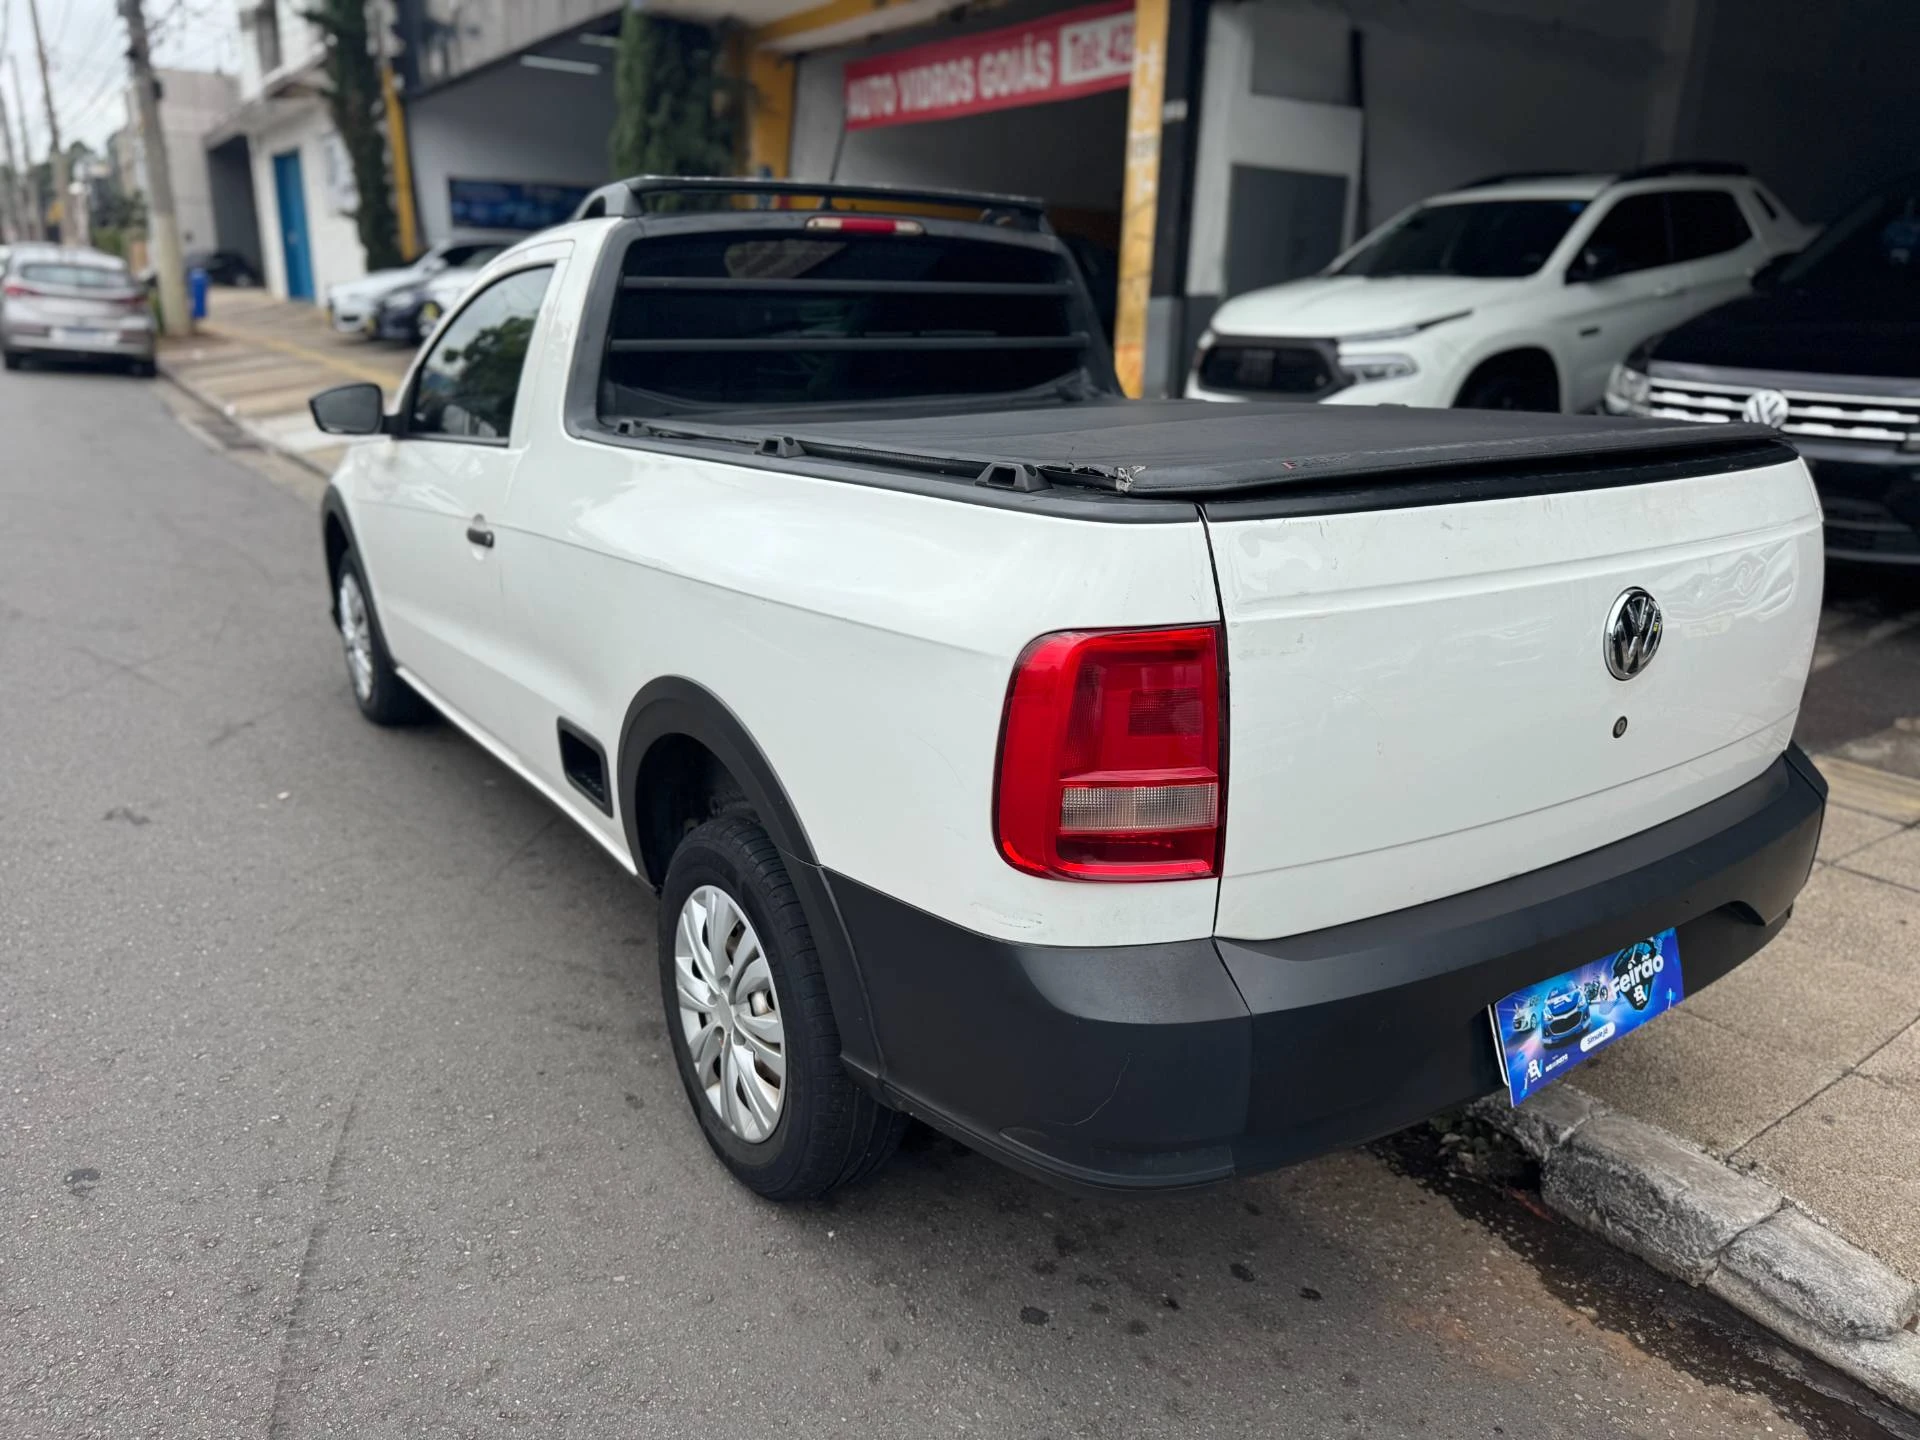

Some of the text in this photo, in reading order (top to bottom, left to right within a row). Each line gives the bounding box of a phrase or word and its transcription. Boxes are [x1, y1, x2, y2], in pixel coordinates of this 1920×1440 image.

[848, 74, 895, 119] AUTO
[898, 58, 974, 110] VIDROS
[980, 33, 1052, 98] GOIÁS
[1608, 954, 1664, 1002] Feirão
